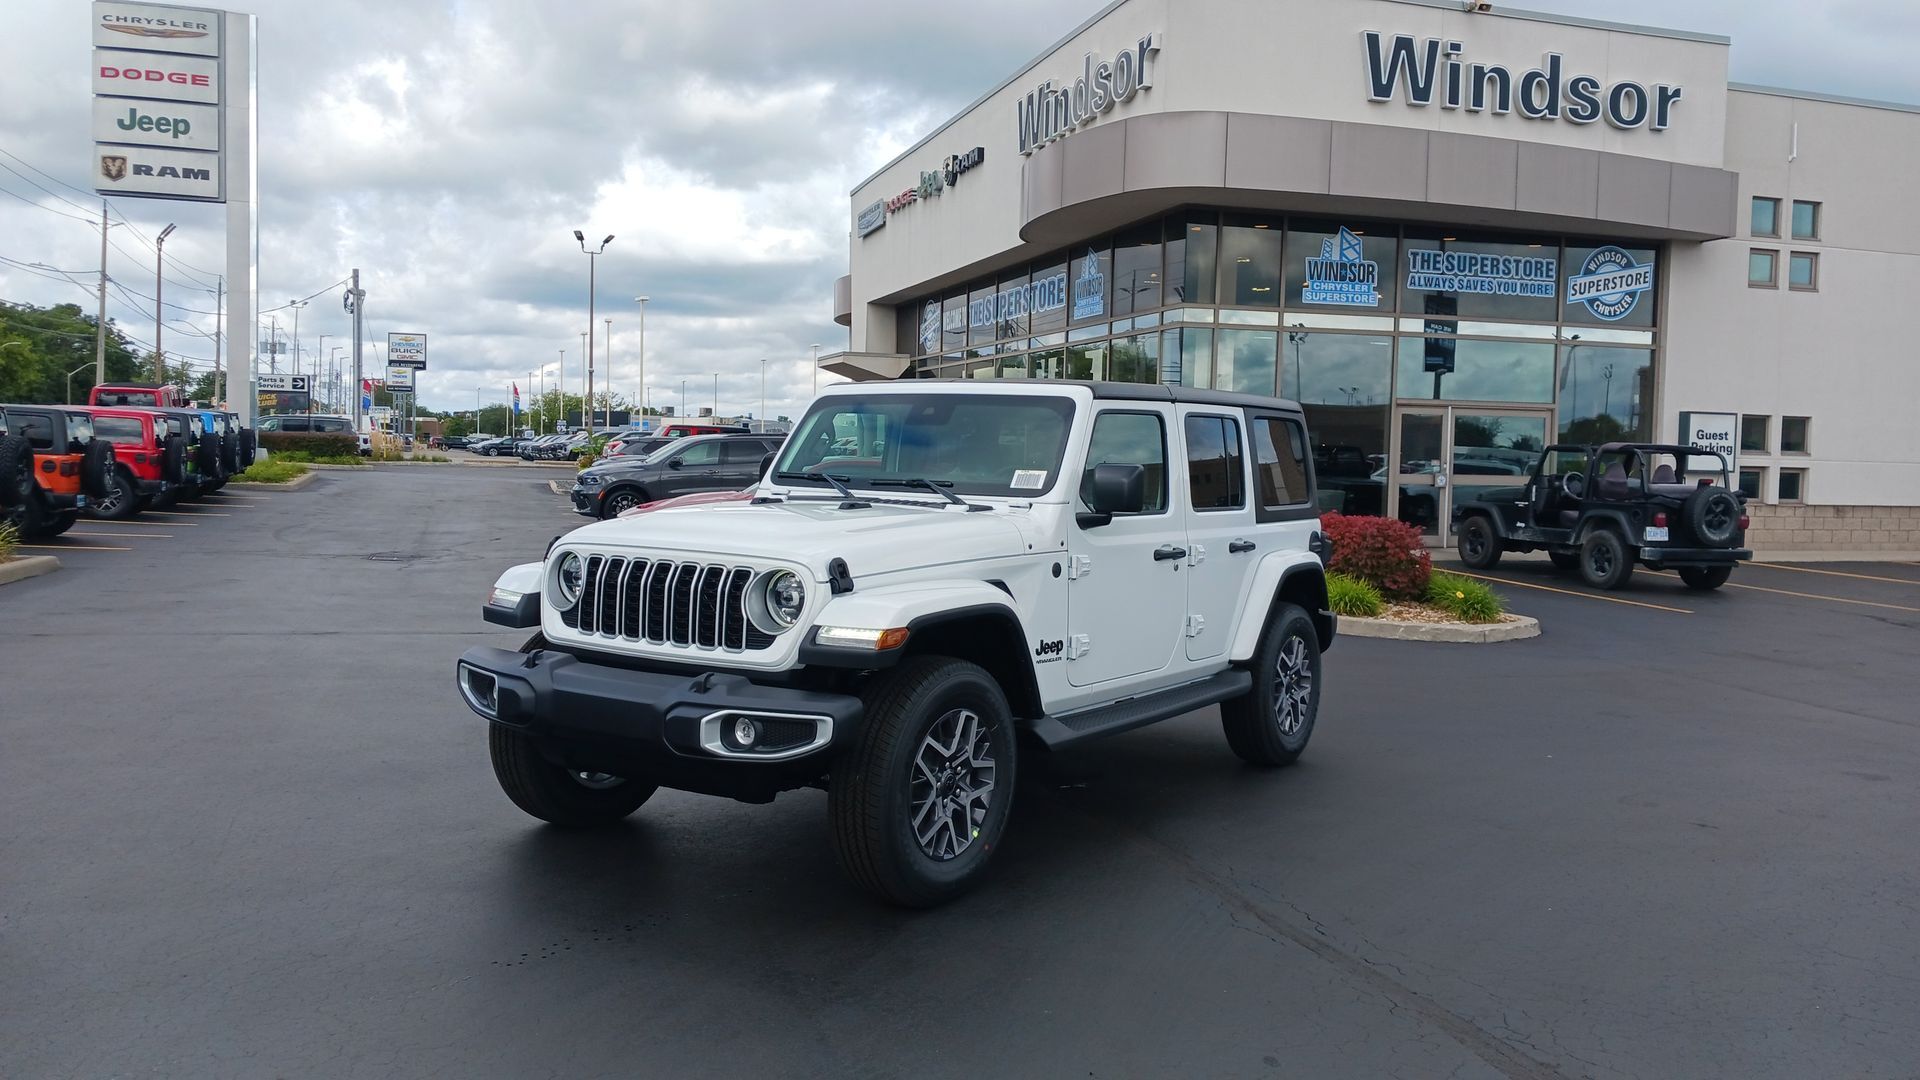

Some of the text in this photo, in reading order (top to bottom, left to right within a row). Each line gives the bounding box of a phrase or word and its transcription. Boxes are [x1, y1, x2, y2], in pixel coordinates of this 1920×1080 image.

[102, 14, 208, 30] CHRYSLER
[100, 66, 210, 87] DODGE
[1361, 30, 1682, 131] Windsor
[1017, 32, 1161, 157] Windsor
[117, 108, 191, 139] Jeep
[132, 163, 211, 181] RAM
[953, 147, 984, 175] RAM
[1307, 259, 1375, 284] WINDSOR
[1409, 250, 1555, 280] THE SUPERSTORE
[1588, 251, 1628, 271] WINDSOR
[1313, 281, 1369, 293] CHRYSLER
[1409, 274, 1554, 297] ALWAYS SAVES YOU MORE!
[1571, 271, 1650, 297] SUPERSTORE
[969, 300, 984, 327] THE
[984, 275, 1066, 324] SUPERSTORE
[1305, 291, 1376, 304] SUPERSTORE
[1593, 294, 1633, 316] CHRYSLER
[390, 347, 424, 355] BUICK
[1696, 429, 1729, 441] Guest
[1035, 639, 1064, 656] Jeep
